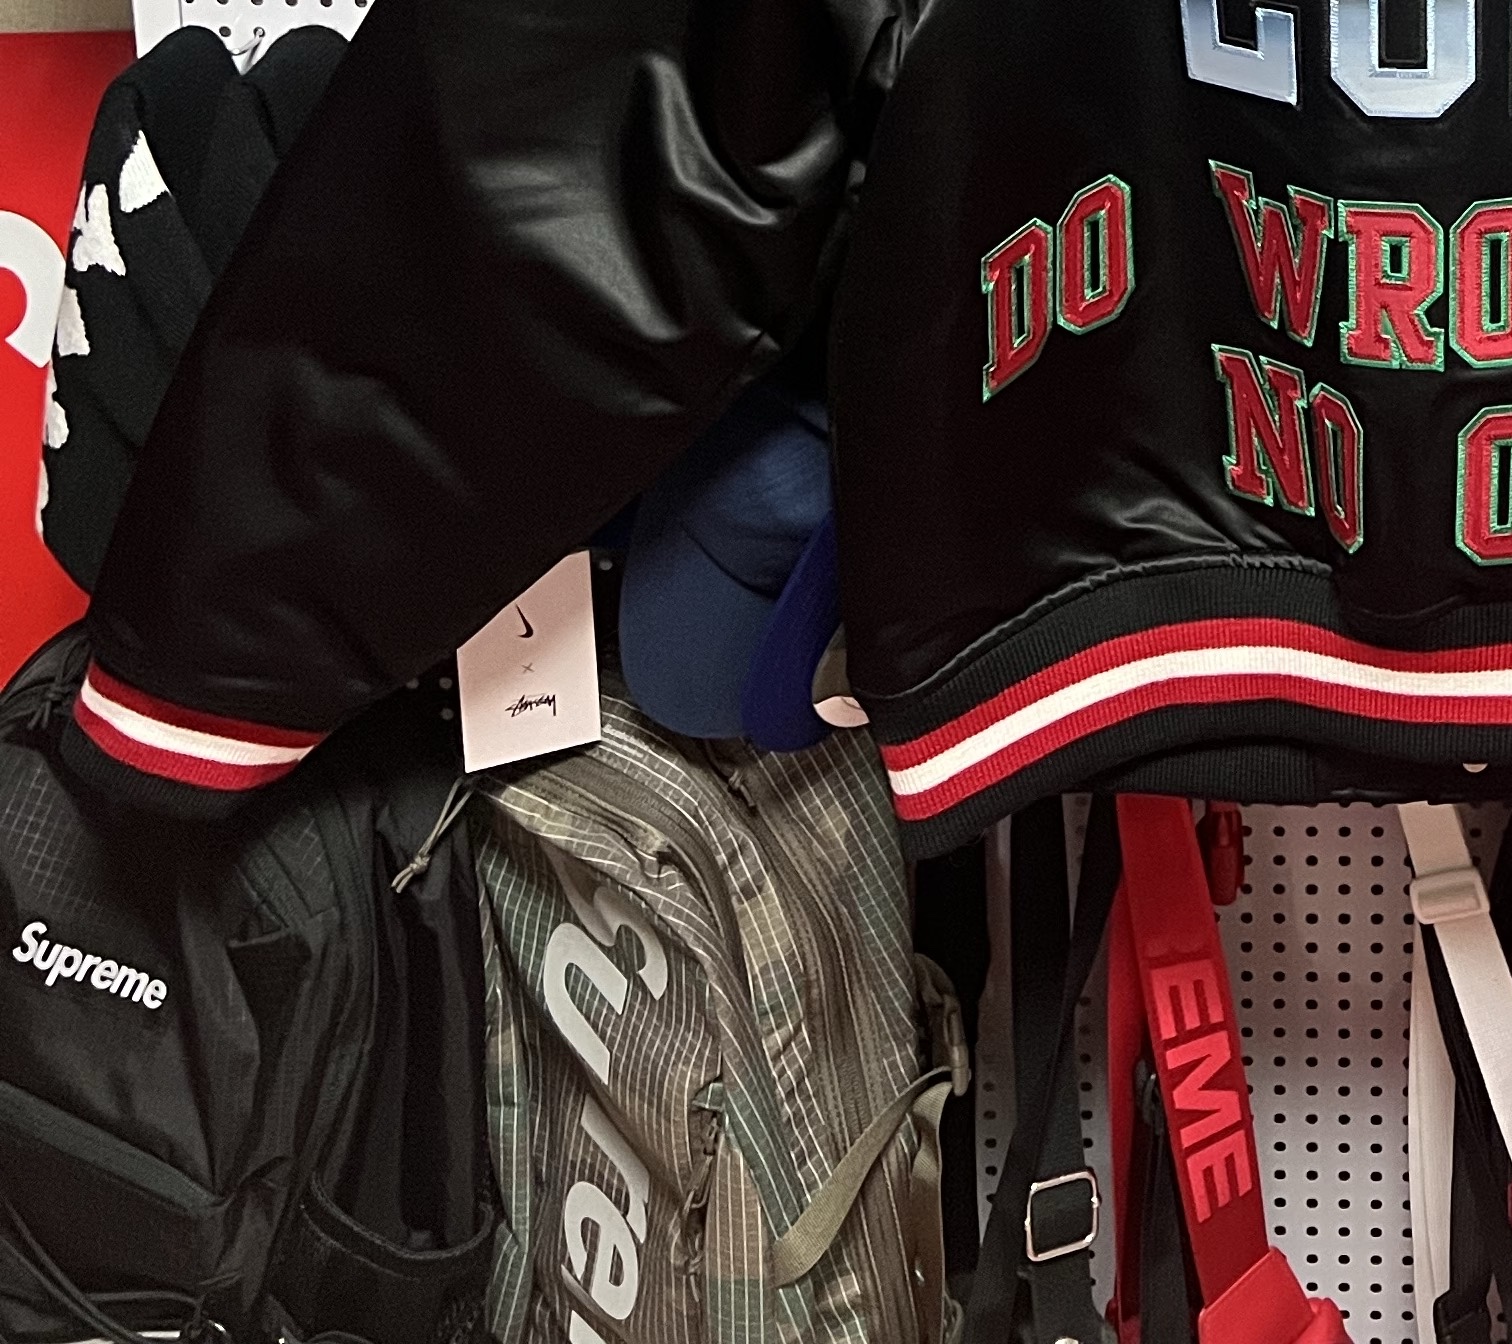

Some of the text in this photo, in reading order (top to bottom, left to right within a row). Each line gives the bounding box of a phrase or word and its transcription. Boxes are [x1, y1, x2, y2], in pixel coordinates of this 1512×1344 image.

[982, 174, 1134, 403] DO
[1210, 343, 1363, 555] NO
[13, 923, 168, 1010] Supreme
